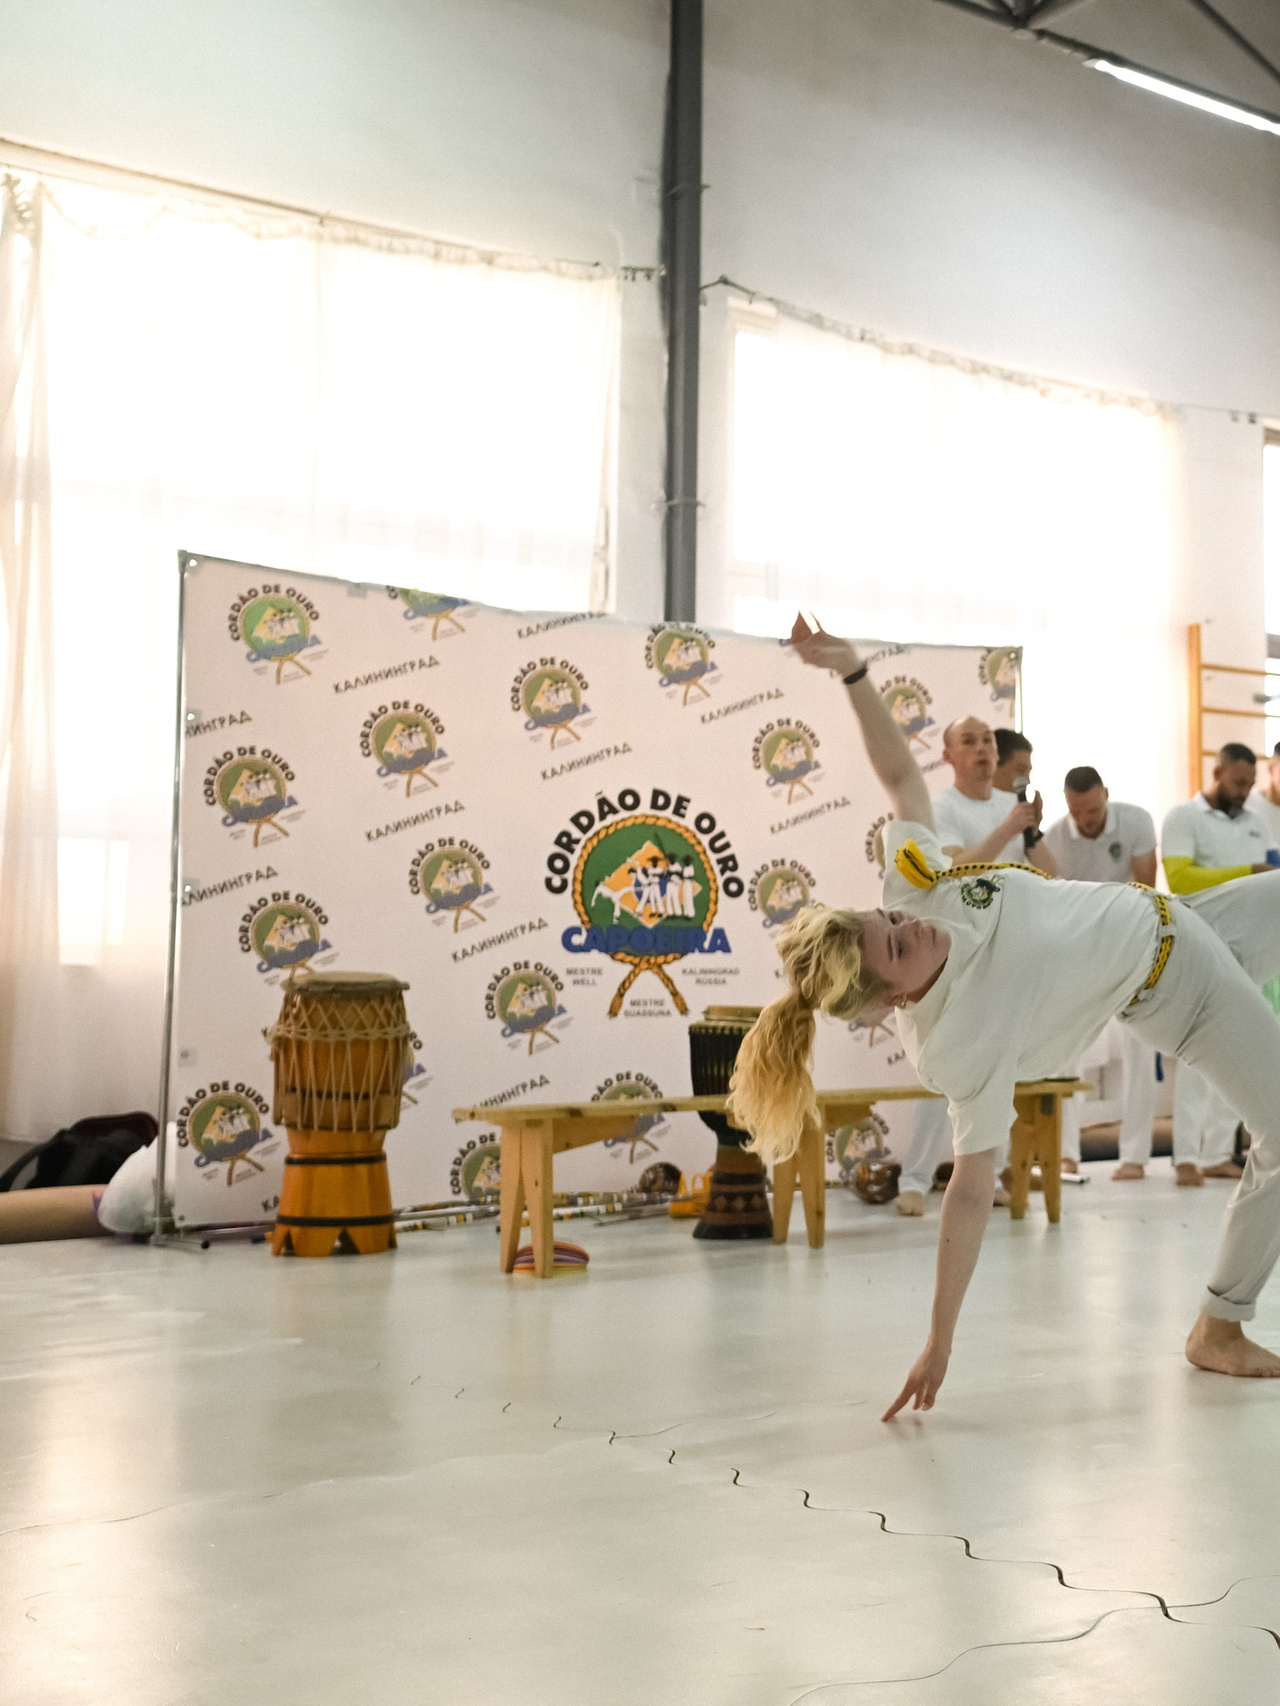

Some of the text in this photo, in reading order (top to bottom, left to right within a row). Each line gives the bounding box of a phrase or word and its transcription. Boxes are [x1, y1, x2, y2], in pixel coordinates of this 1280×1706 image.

[262, 584, 281, 594] DE
[286, 588, 320, 621] OURO
[539, 657, 556, 666] DE
[560, 659, 589, 690] OURO
[392, 700, 410, 710] DE
[414, 703, 445, 735] OURO
[237, 746, 257, 756] DE
[261, 749, 296, 782] OURO
[438, 837, 455, 847] DE
[459, 839, 490, 870] OURO
[545, 788, 745, 898] CORDÃO DE OURO
[271, 891, 290, 901] DE
[294, 893, 329, 926] OURO
[561, 926, 732, 953] CAPOEIRA
[513, 960, 530, 970] DE
[534, 963, 564, 992] OURO
[210, 1081, 230, 1093] DE
[234, 1082, 270, 1115] OURO
